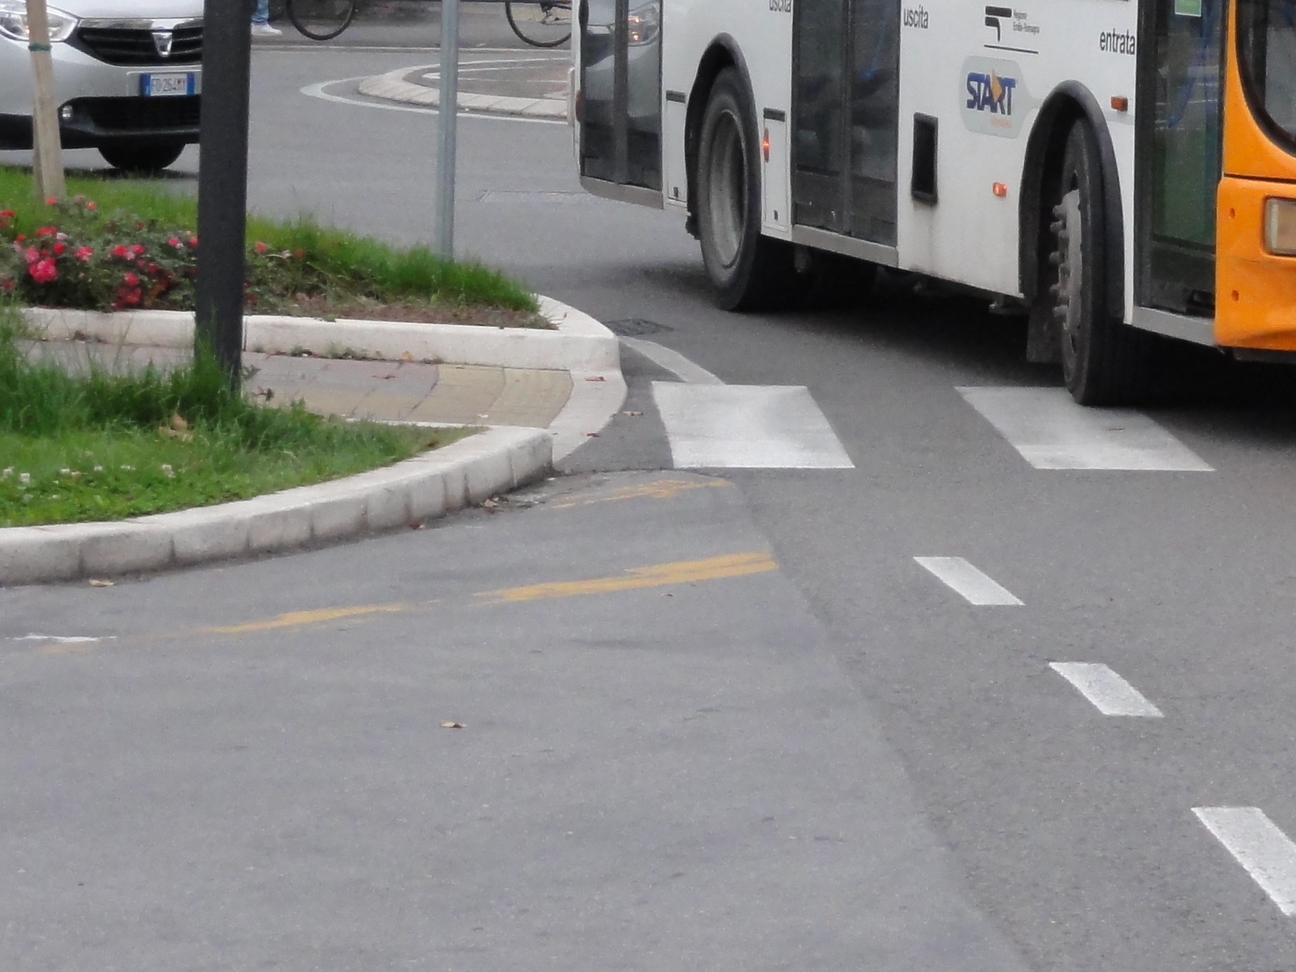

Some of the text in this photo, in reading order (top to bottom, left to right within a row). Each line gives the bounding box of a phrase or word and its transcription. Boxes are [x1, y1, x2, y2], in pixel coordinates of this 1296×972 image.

[903, 4, 929, 29] uscita
[1100, 28, 1136, 55] entrata
[966, 72, 1016, 115] START
